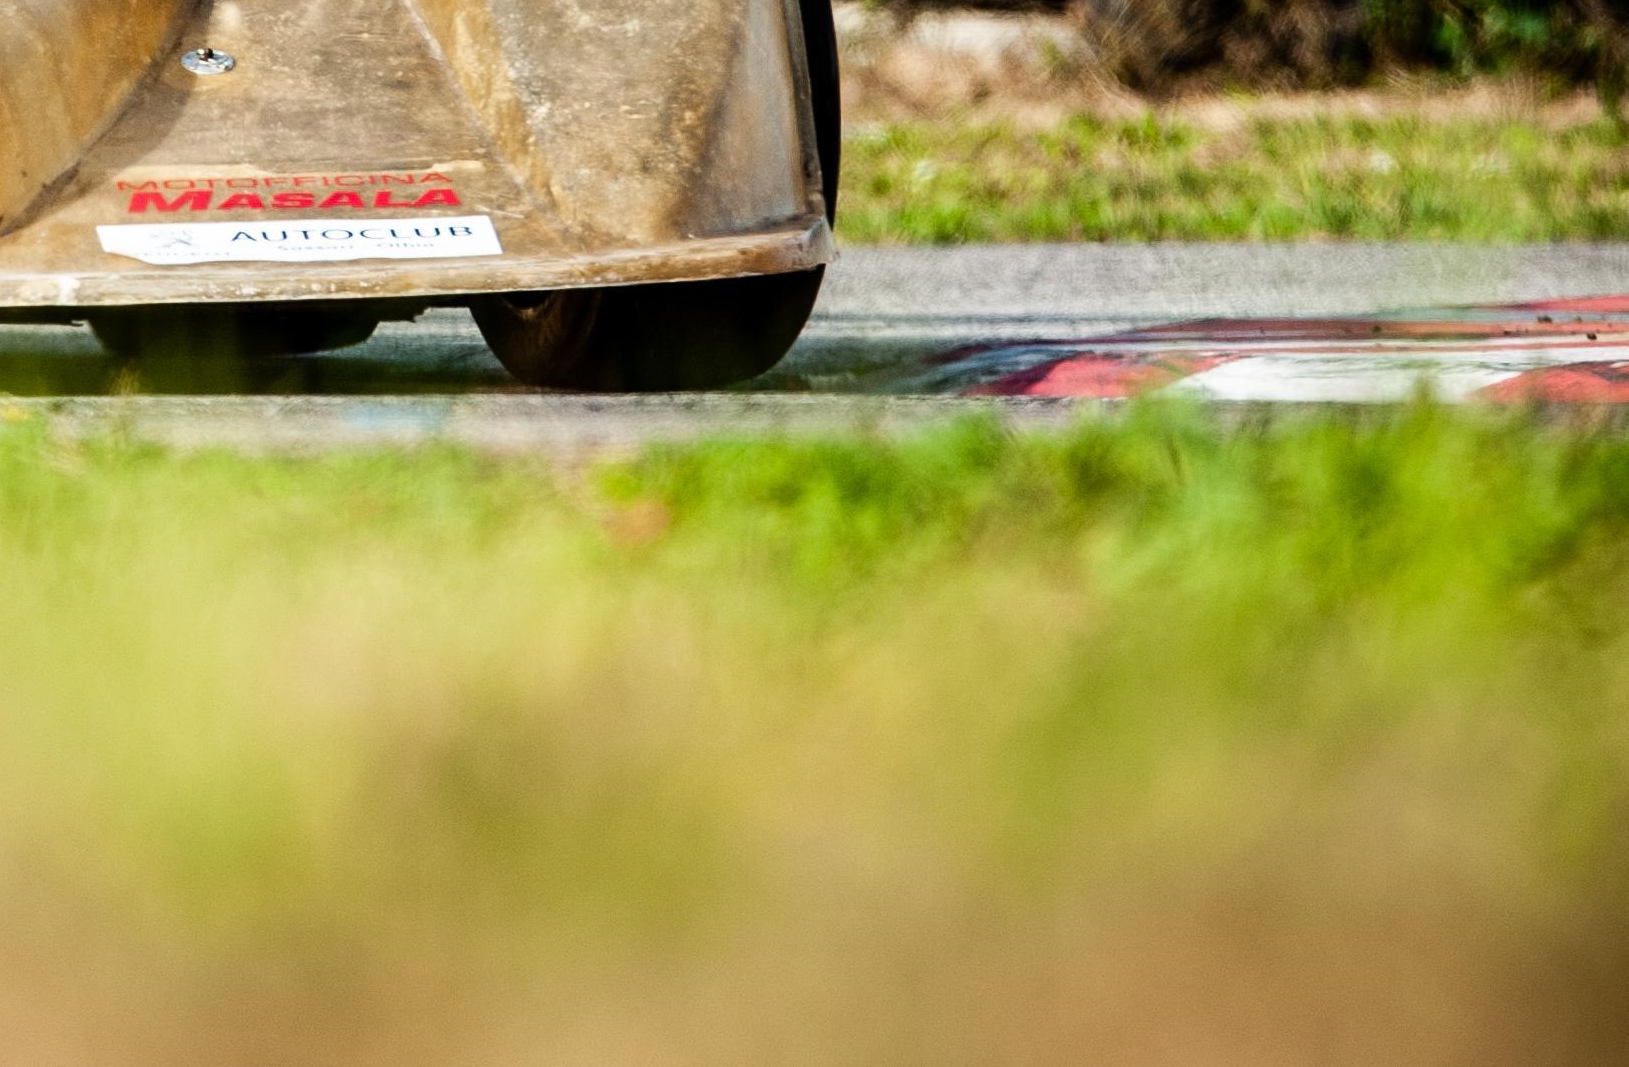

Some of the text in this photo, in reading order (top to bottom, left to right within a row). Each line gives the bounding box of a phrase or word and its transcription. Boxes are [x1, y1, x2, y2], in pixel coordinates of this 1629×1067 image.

[116, 171, 454, 192] MOTOFFICINA
[127, 187, 463, 214] MASALA
[231, 225, 474, 243] AUTOCLUB
